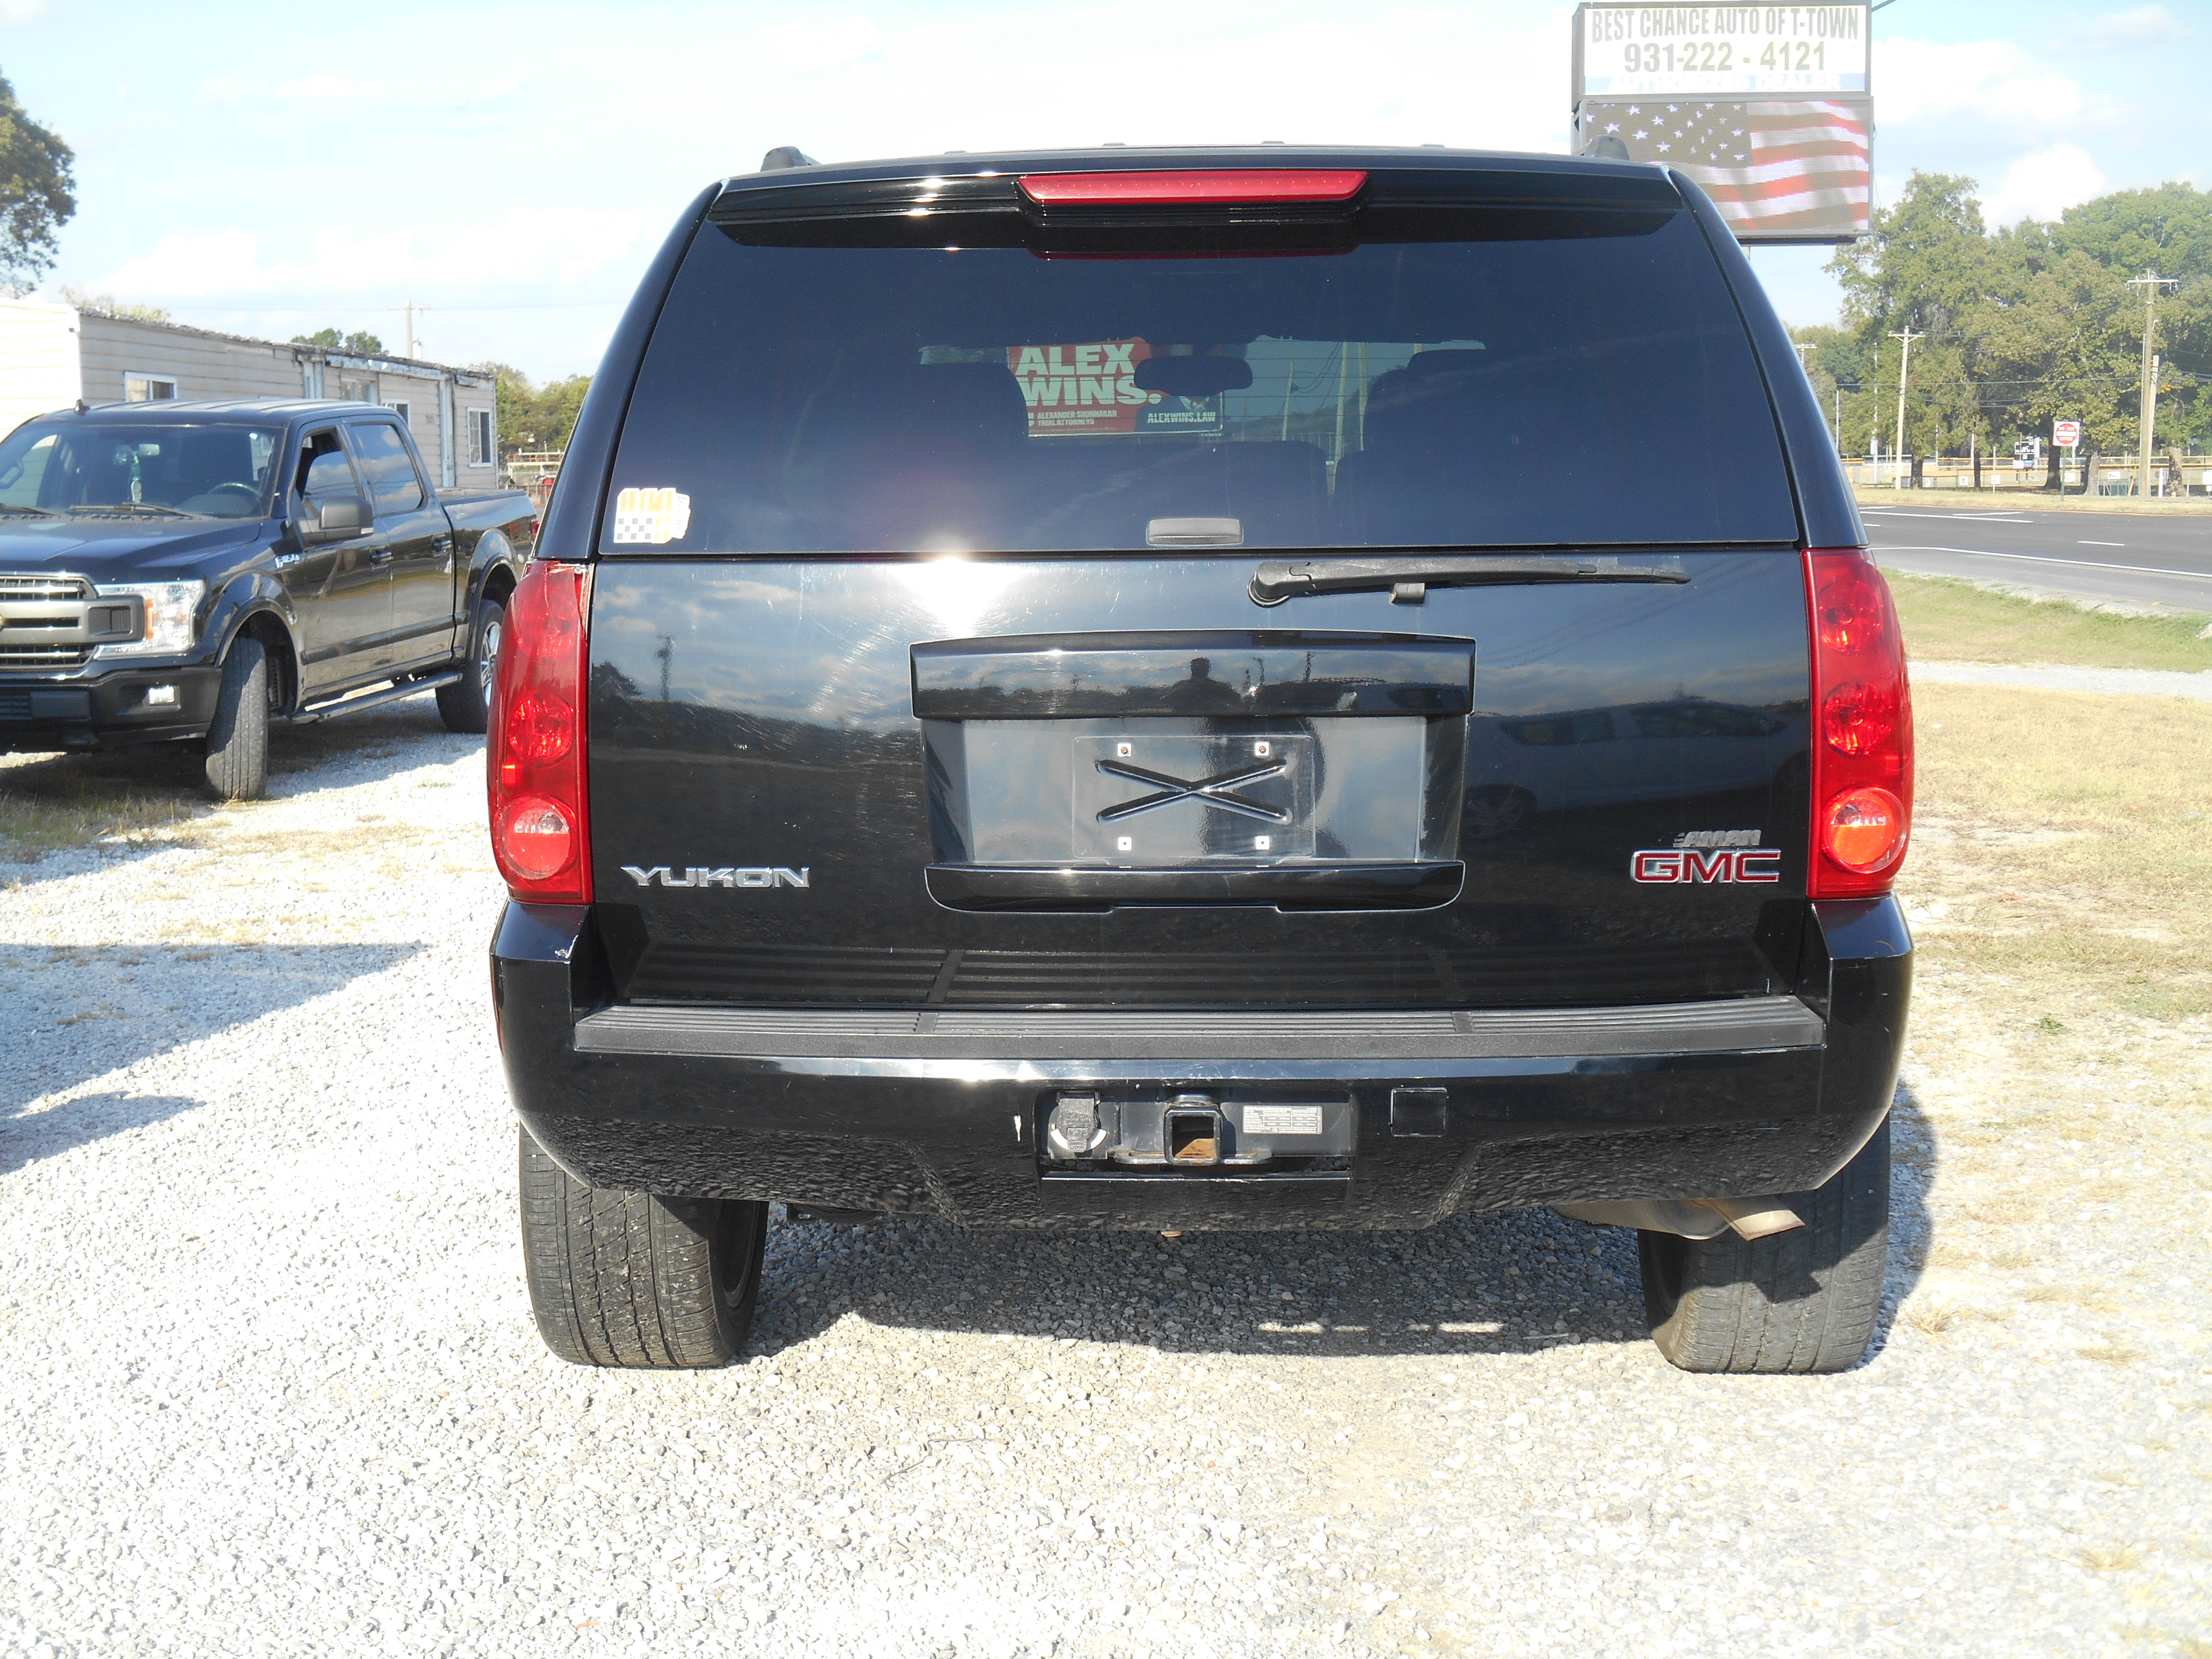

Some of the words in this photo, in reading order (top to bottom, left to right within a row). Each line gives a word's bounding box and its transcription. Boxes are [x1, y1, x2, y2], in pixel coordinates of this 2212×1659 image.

[1592, 10, 1635, 43] BEST
[1641, 8, 1709, 38] CHANCE
[1714, 7, 1759, 34] AUTO
[1766, 7, 1786, 35] OF
[1791, 7, 1858, 40] T-TOWN
[1624, 42, 1732, 73] 931-222
[1760, 41, 1824, 70] 4121
[1609, 74, 1750, 92] AUTHORIZED
[1756, 73, 1841, 91] DEALER
[1015, 344, 1135, 375] ALEX
[1016, 375, 1161, 406] WINS.
[1038, 410, 1076, 419] ALEXANDER
[1076, 410, 1117, 418] SHUNNARAH
[1148, 412, 1216, 423] ALEXWINS.LAW
[620, 866, 810, 888] YUKON
[1631, 849, 1781, 883] GMC
